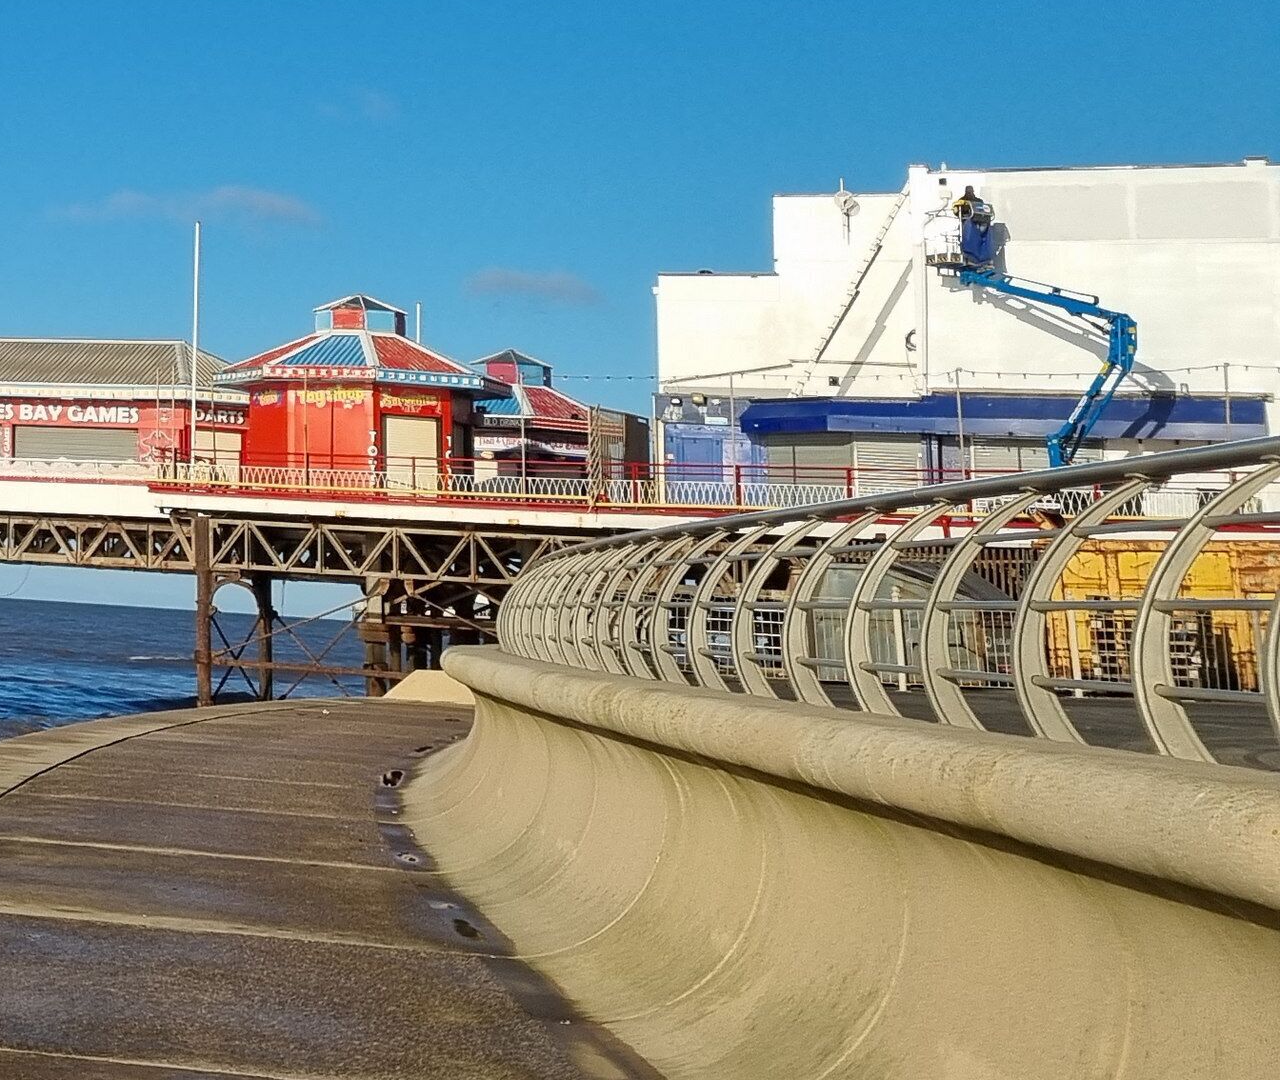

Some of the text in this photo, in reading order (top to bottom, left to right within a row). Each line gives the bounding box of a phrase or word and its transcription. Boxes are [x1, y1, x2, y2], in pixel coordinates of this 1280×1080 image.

[19, 404, 63, 421] BAY
[66, 405, 139, 423] GAMES
[195, 409, 245, 424] DARTS
